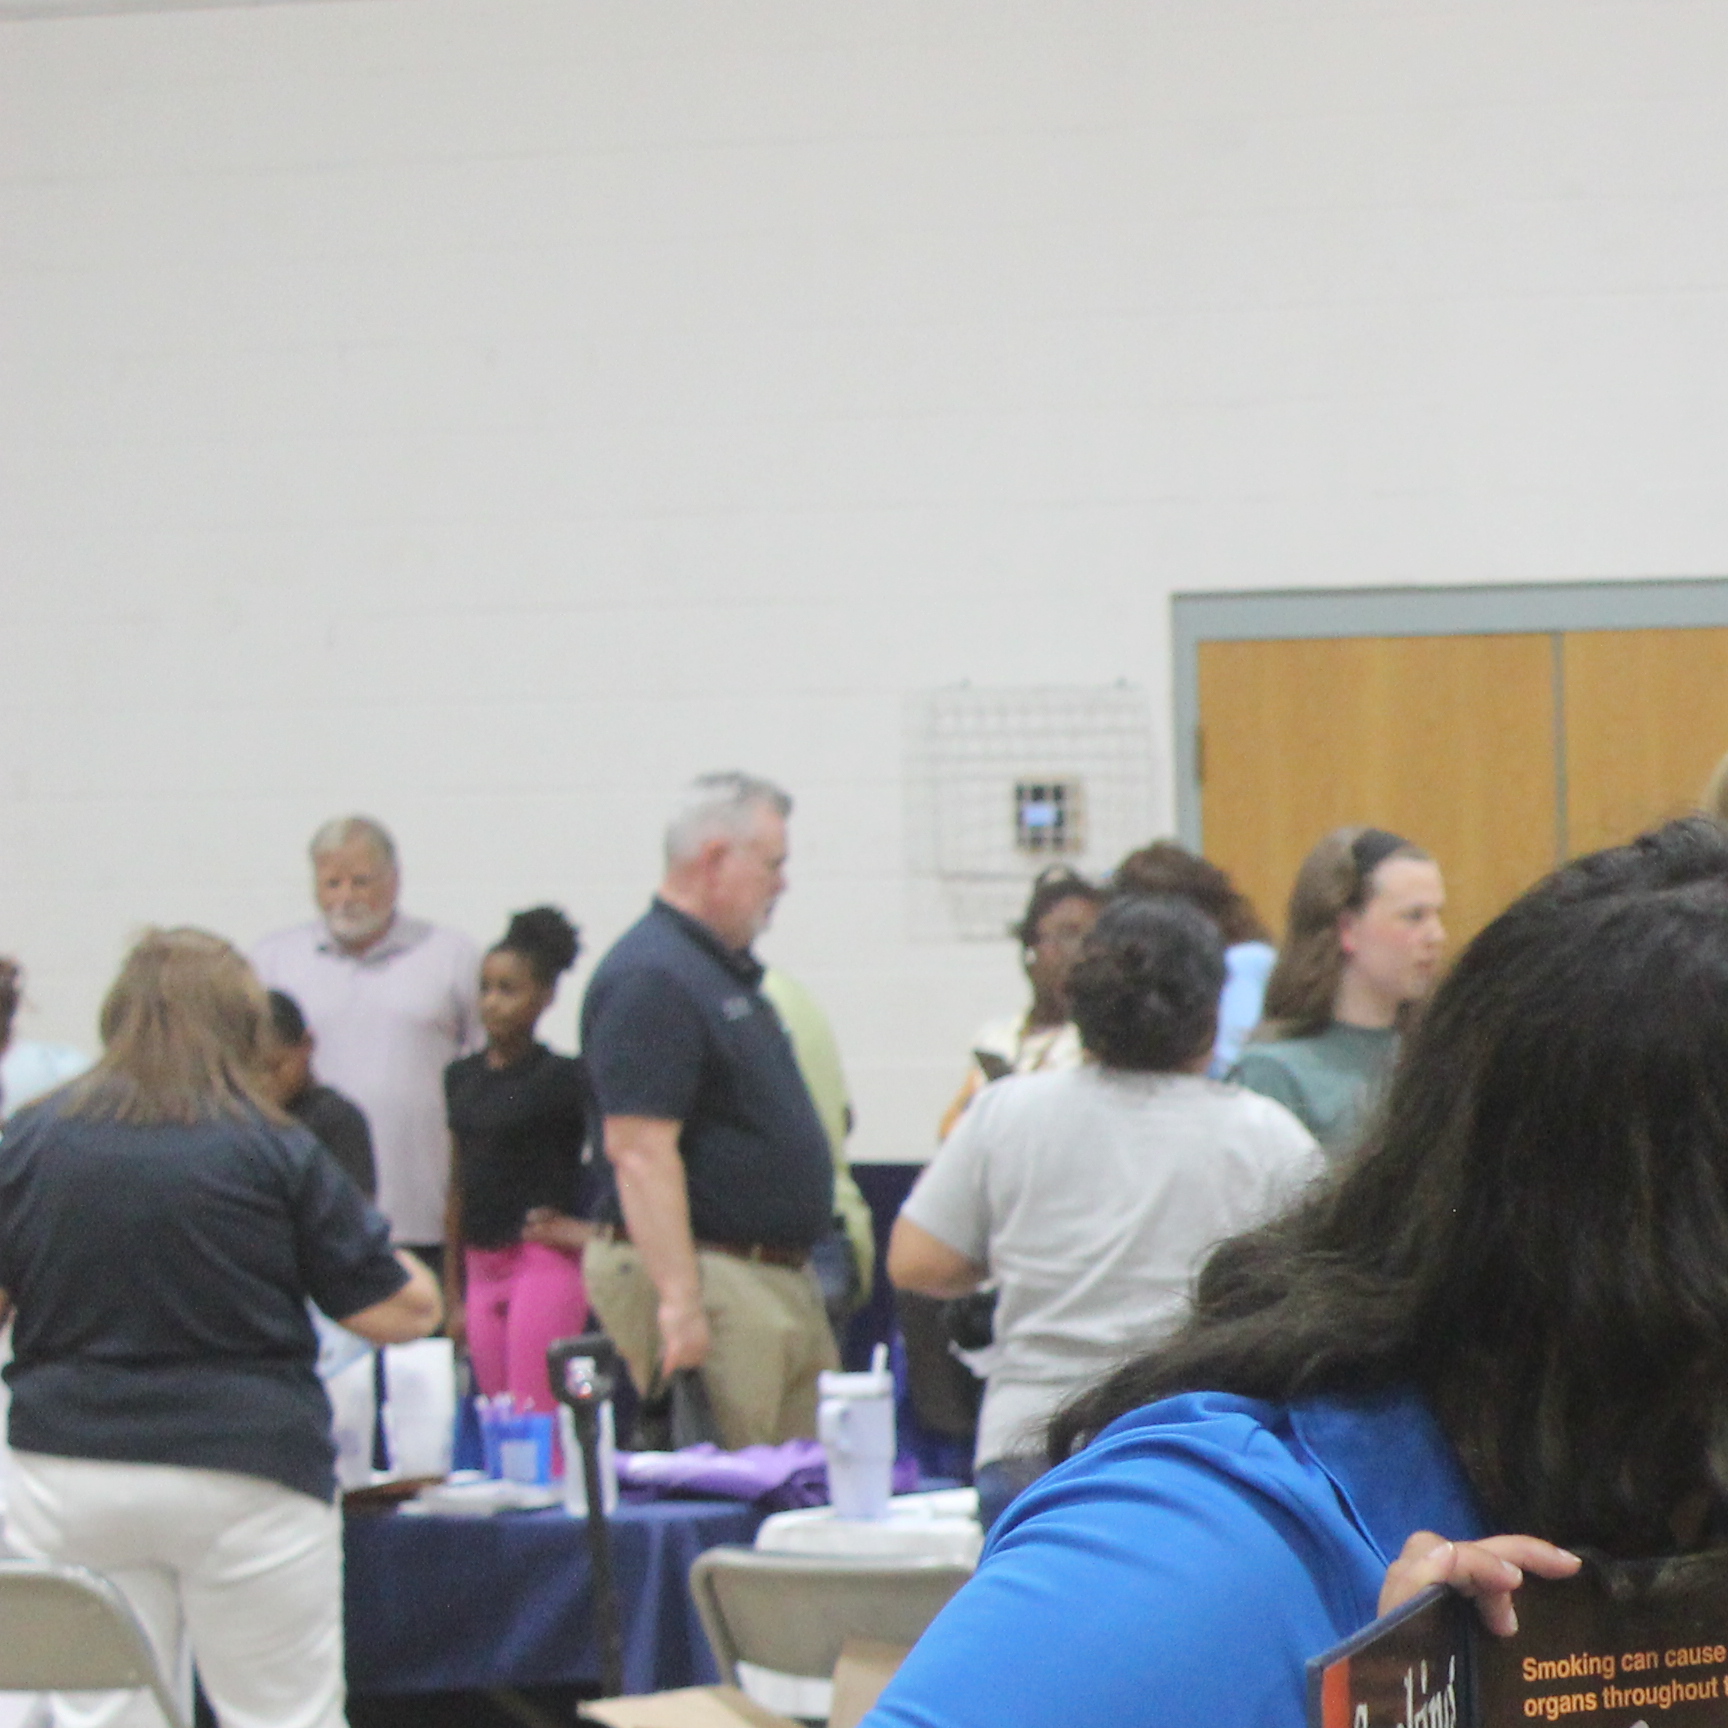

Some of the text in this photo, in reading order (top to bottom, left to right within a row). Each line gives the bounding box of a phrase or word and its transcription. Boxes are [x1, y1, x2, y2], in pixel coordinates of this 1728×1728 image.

[1522, 1653, 1616, 1682] Smoking
[1621, 1649, 1658, 1672] can
[1664, 1645, 1726, 1668] cause
[1523, 1691, 1598, 1721] organs
[1602, 1676, 1718, 1710] throughout
